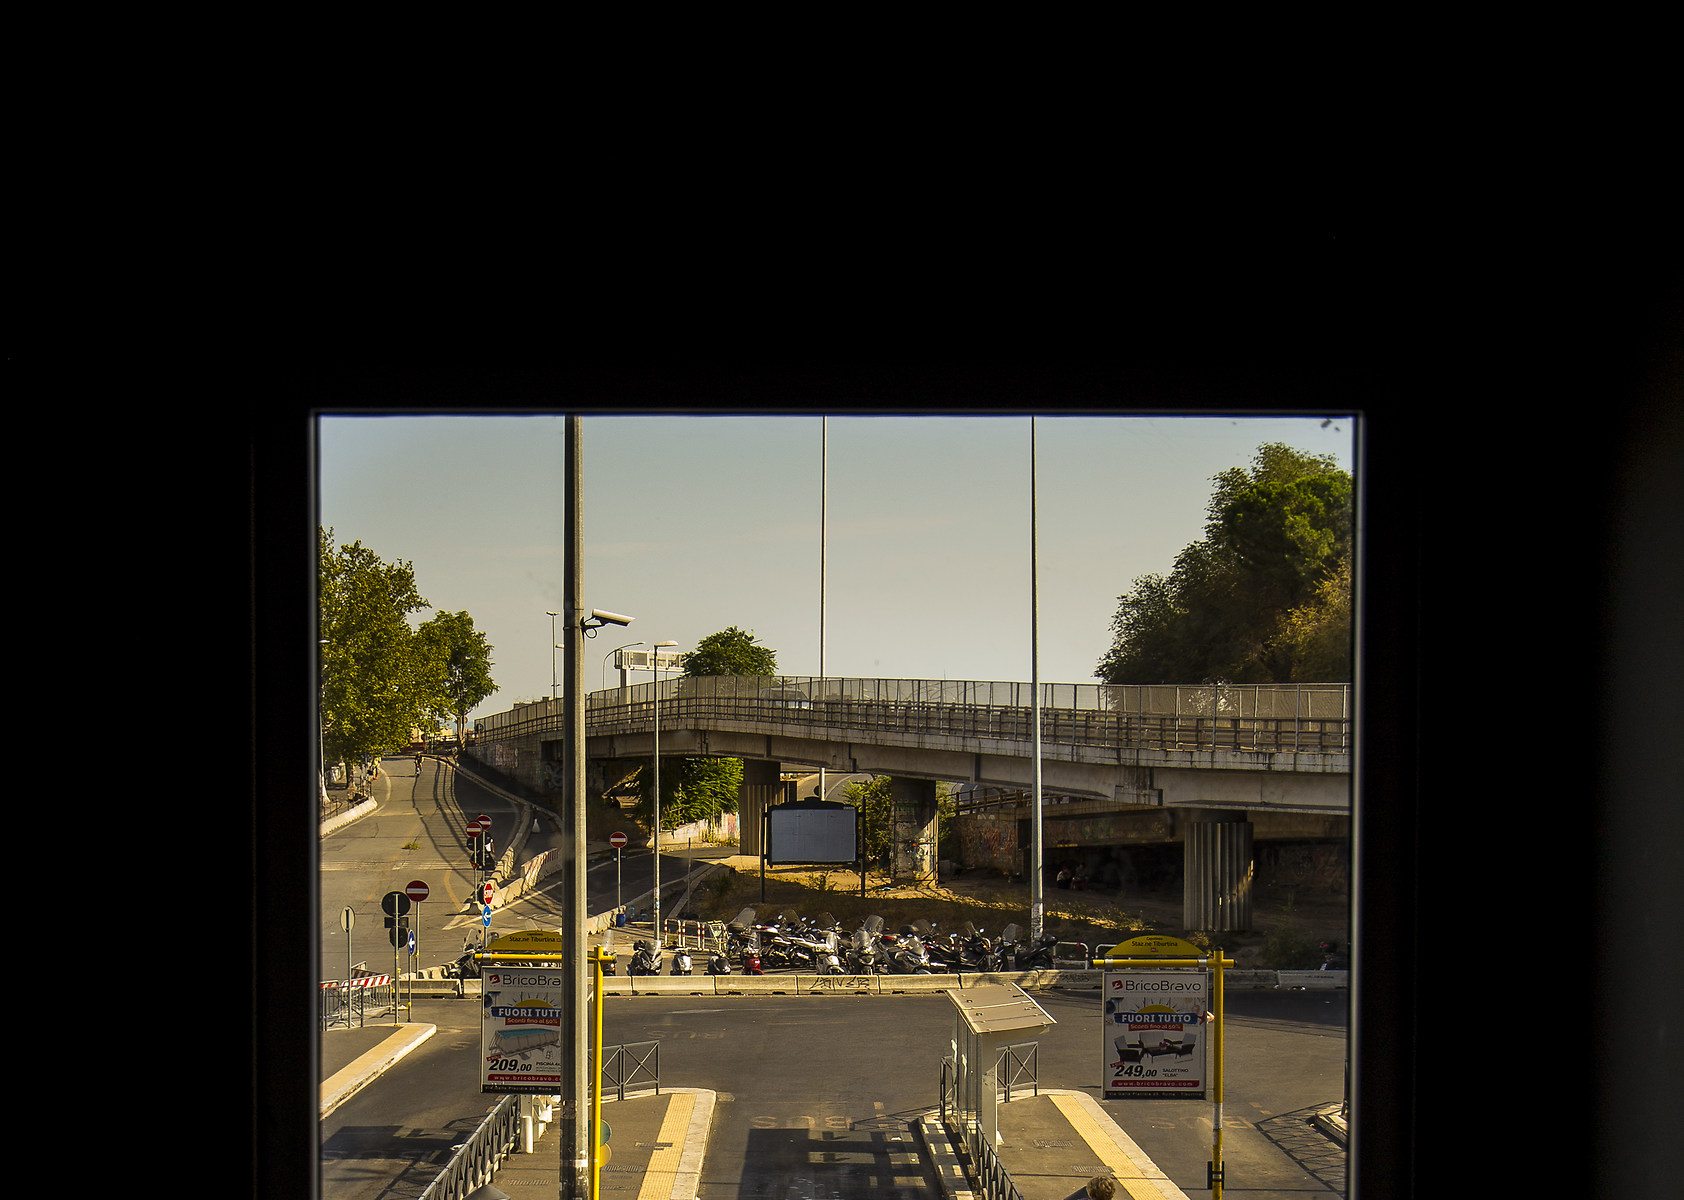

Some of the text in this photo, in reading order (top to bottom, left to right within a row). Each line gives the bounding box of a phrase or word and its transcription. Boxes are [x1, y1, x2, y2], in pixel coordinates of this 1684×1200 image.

[1125, 979, 1201, 991] BricoBravo
[498, 1008, 561, 1017] FUORI TUTT
[1121, 1014, 1191, 1023] FUORI TUTTO
[489, 1059, 532, 1072] 209,00
[1114, 1064, 1157, 1078] 249,00
